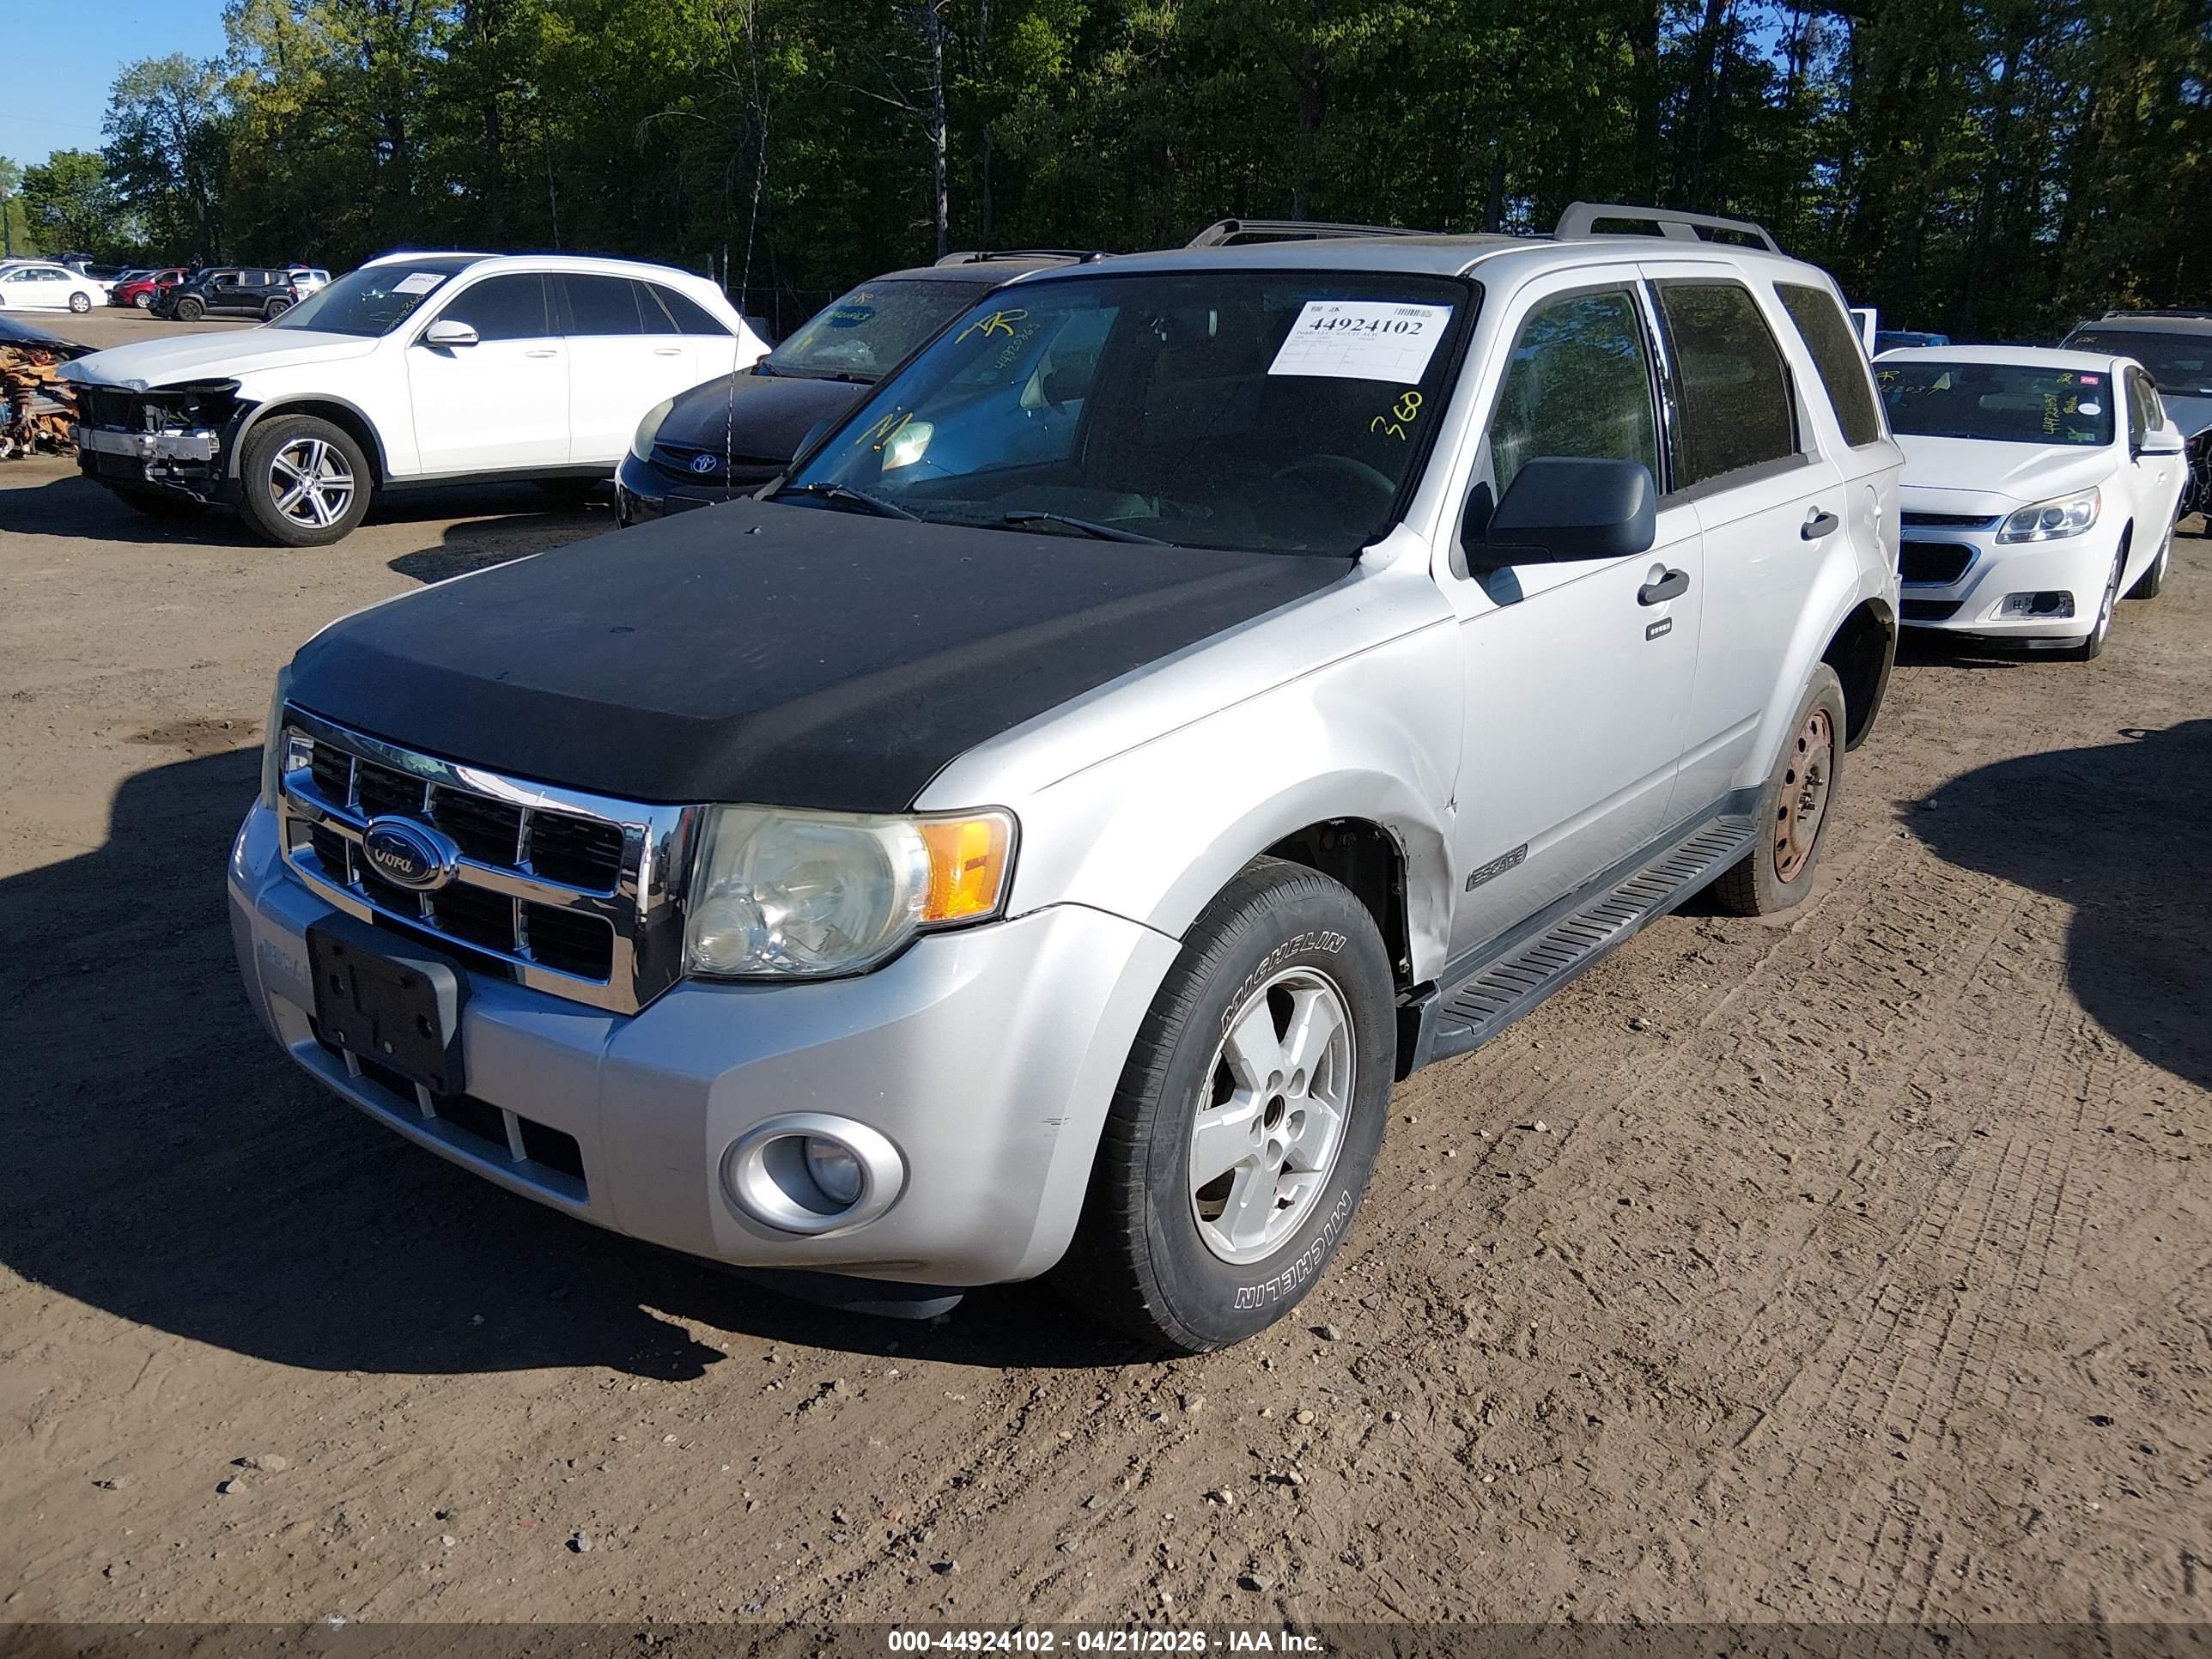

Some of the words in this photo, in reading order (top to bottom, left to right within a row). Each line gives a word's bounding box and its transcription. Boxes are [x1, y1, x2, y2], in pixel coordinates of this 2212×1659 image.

[1309, 318, 1423, 336] 44924102
[1370, 391, 1423, 441] 360
[1221, 931, 1347, 1036] MICHELIN
[1234, 1189, 1353, 1310] MICHELIN
